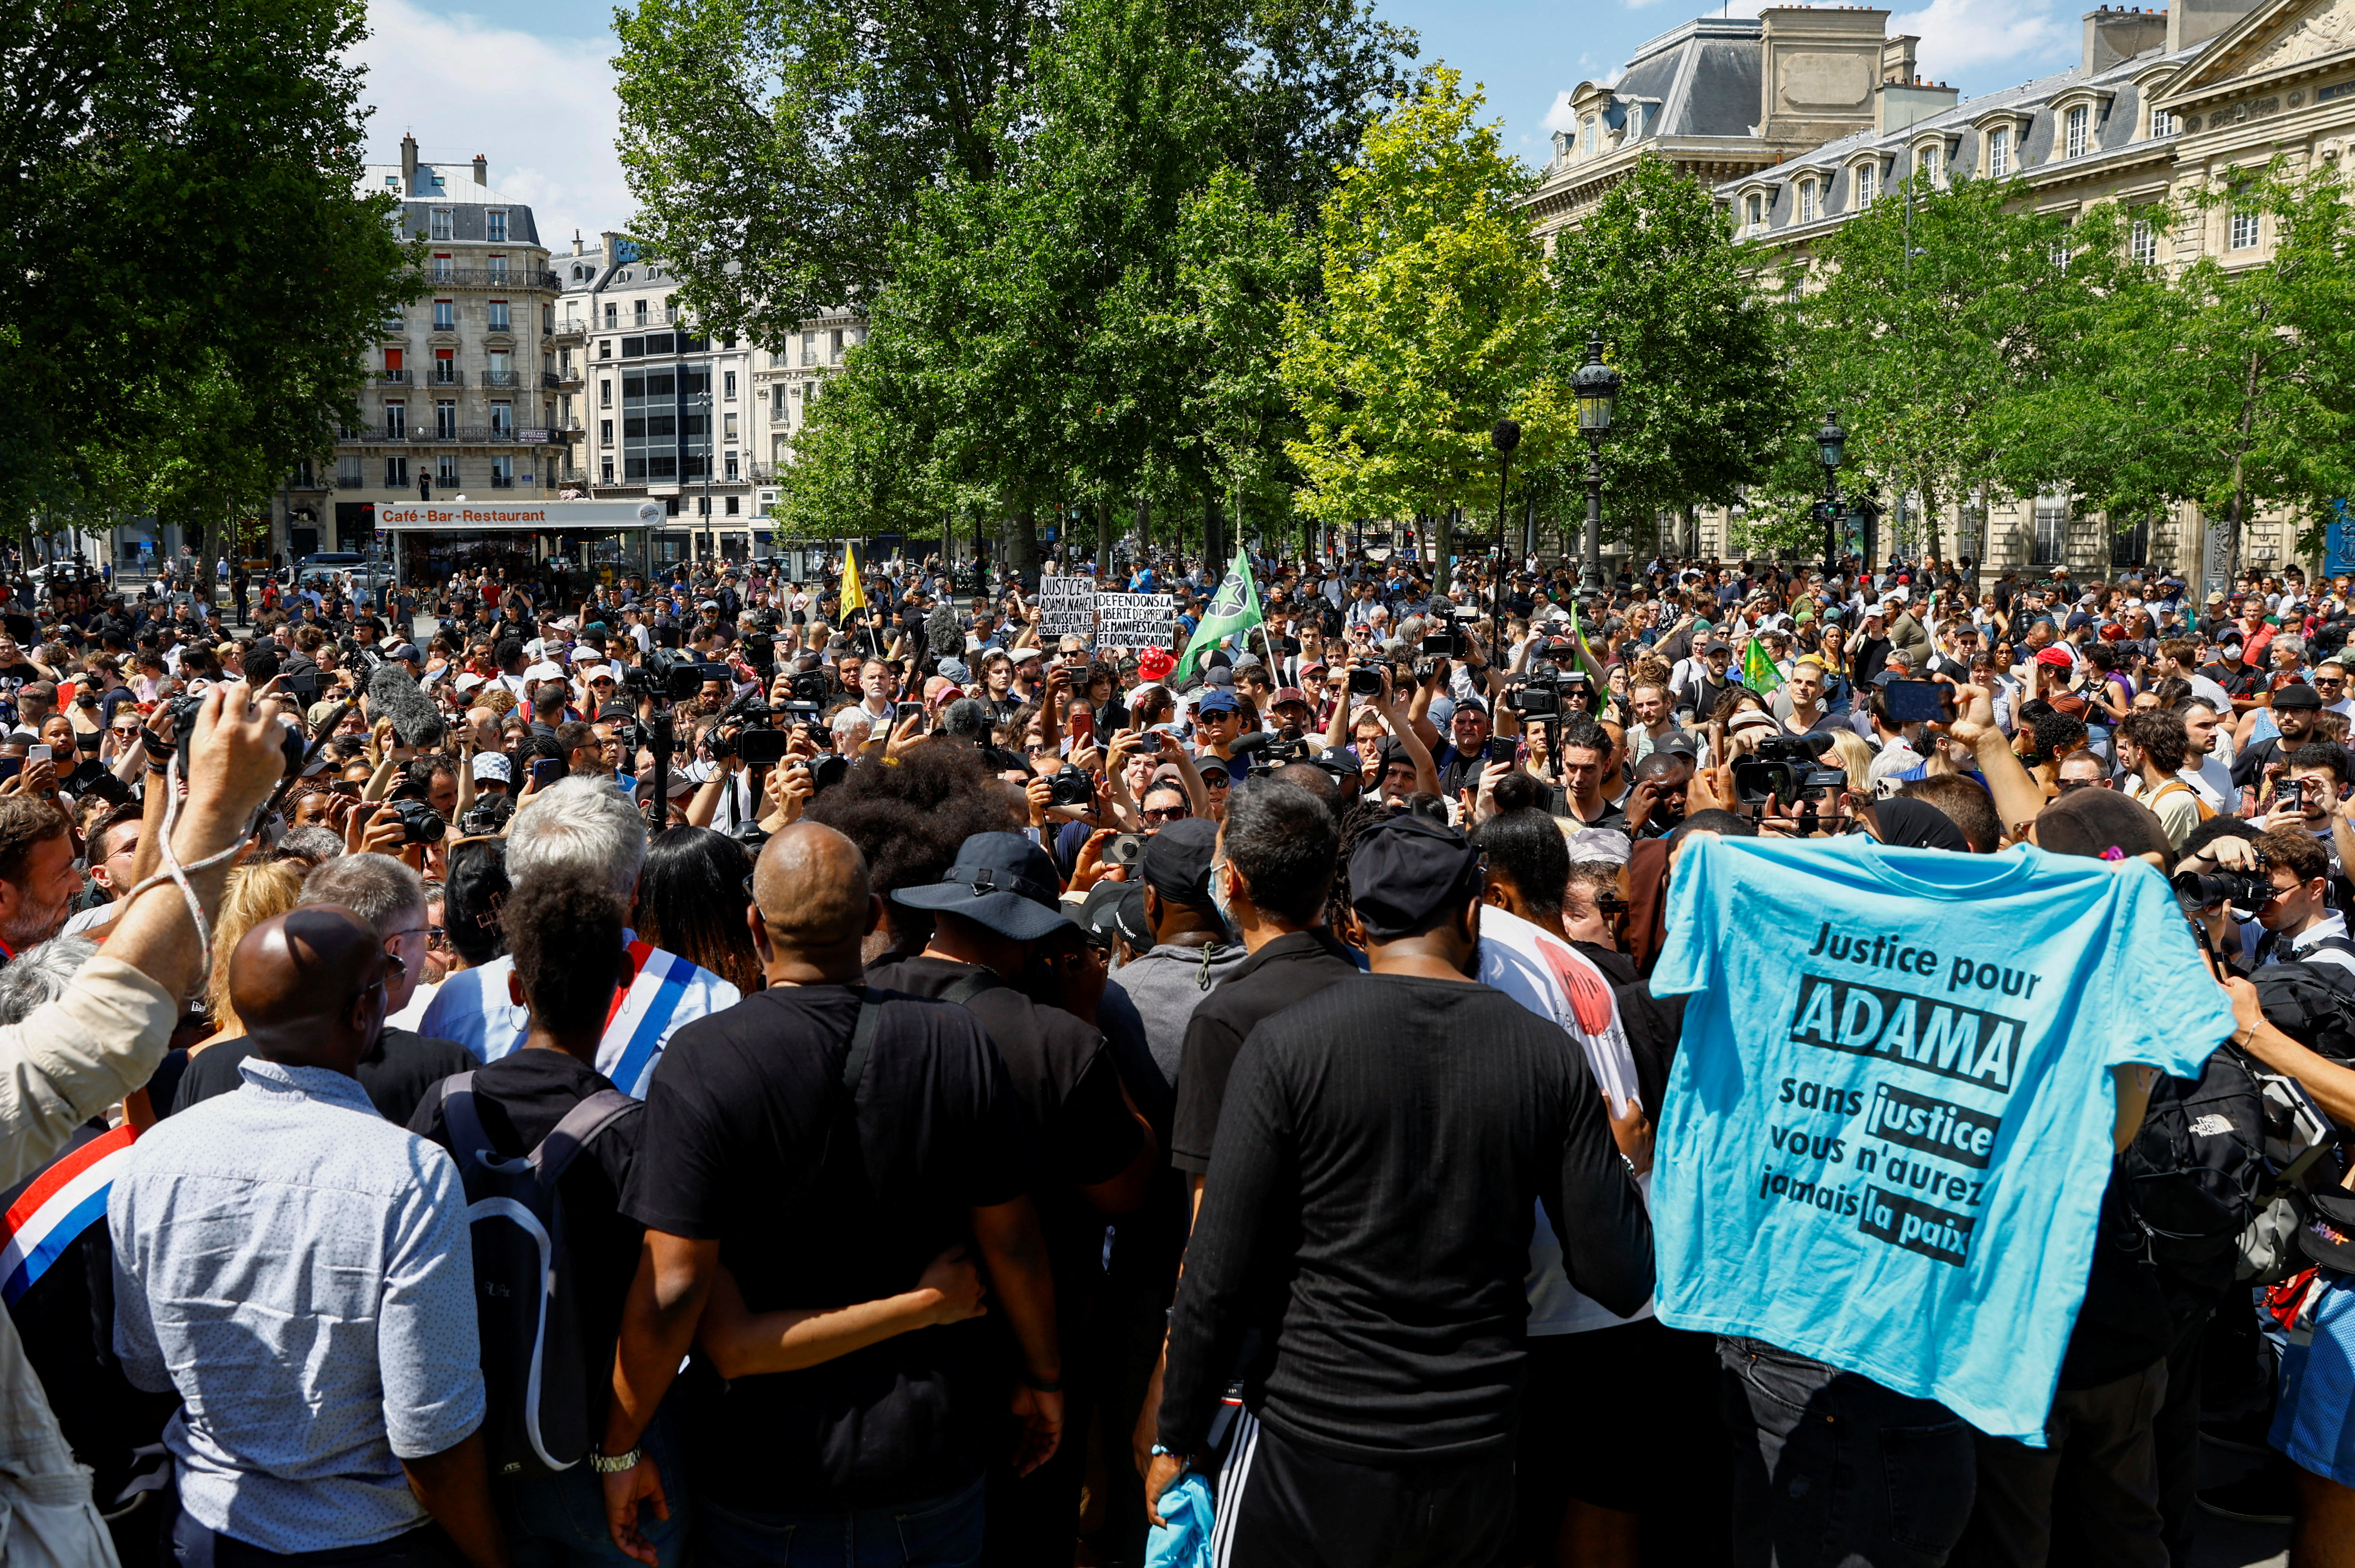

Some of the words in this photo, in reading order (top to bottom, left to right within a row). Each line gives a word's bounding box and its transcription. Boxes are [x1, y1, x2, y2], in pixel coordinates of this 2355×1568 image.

[1042, 579, 1082, 596] JUSTICE
[1083, 581, 1093, 593] POUR
[1068, 597, 1093, 612] NAHEL
[1161, 597, 1172, 607] LA
[1038, 613, 1082, 626] ALHOUSSEIN
[1084, 613, 1092, 623] ET
[1098, 607, 1132, 620] LIBERTÉ
[1133, 609, 1173, 621] D'EXPRESSION
[1038, 625, 1056, 634] TOUS
[1058, 624, 1069, 633] LES
[1071, 624, 1094, 633] AUTRES
[1098, 621, 1110, 632] DE
[1111, 620, 1173, 634] MANIFESTATION
[1098, 634, 1109, 644] ET
[1321, 749, 1333, 760] LA
[1123, 926, 1137, 939] FIGHT
[1808, 921, 1938, 976] Justice
[1947, 956, 2042, 1000] pour
[1792, 981, 2015, 1086] ADAMA
[1778, 1077, 1864, 1116] sans
[1866, 1086, 1996, 1156] justice
[2195, 1115, 2213, 1124] THE
[2188, 1122, 2216, 1133] NORTH
[2198, 1128, 2219, 1138] FACE
[1770, 1124, 1846, 1164] vous
[1856, 1143, 1986, 1207] n'aurez
[1759, 1164, 1860, 1216] jamais
[1864, 1189, 1894, 1230] la
[1898, 1219, 1970, 1255] paix
